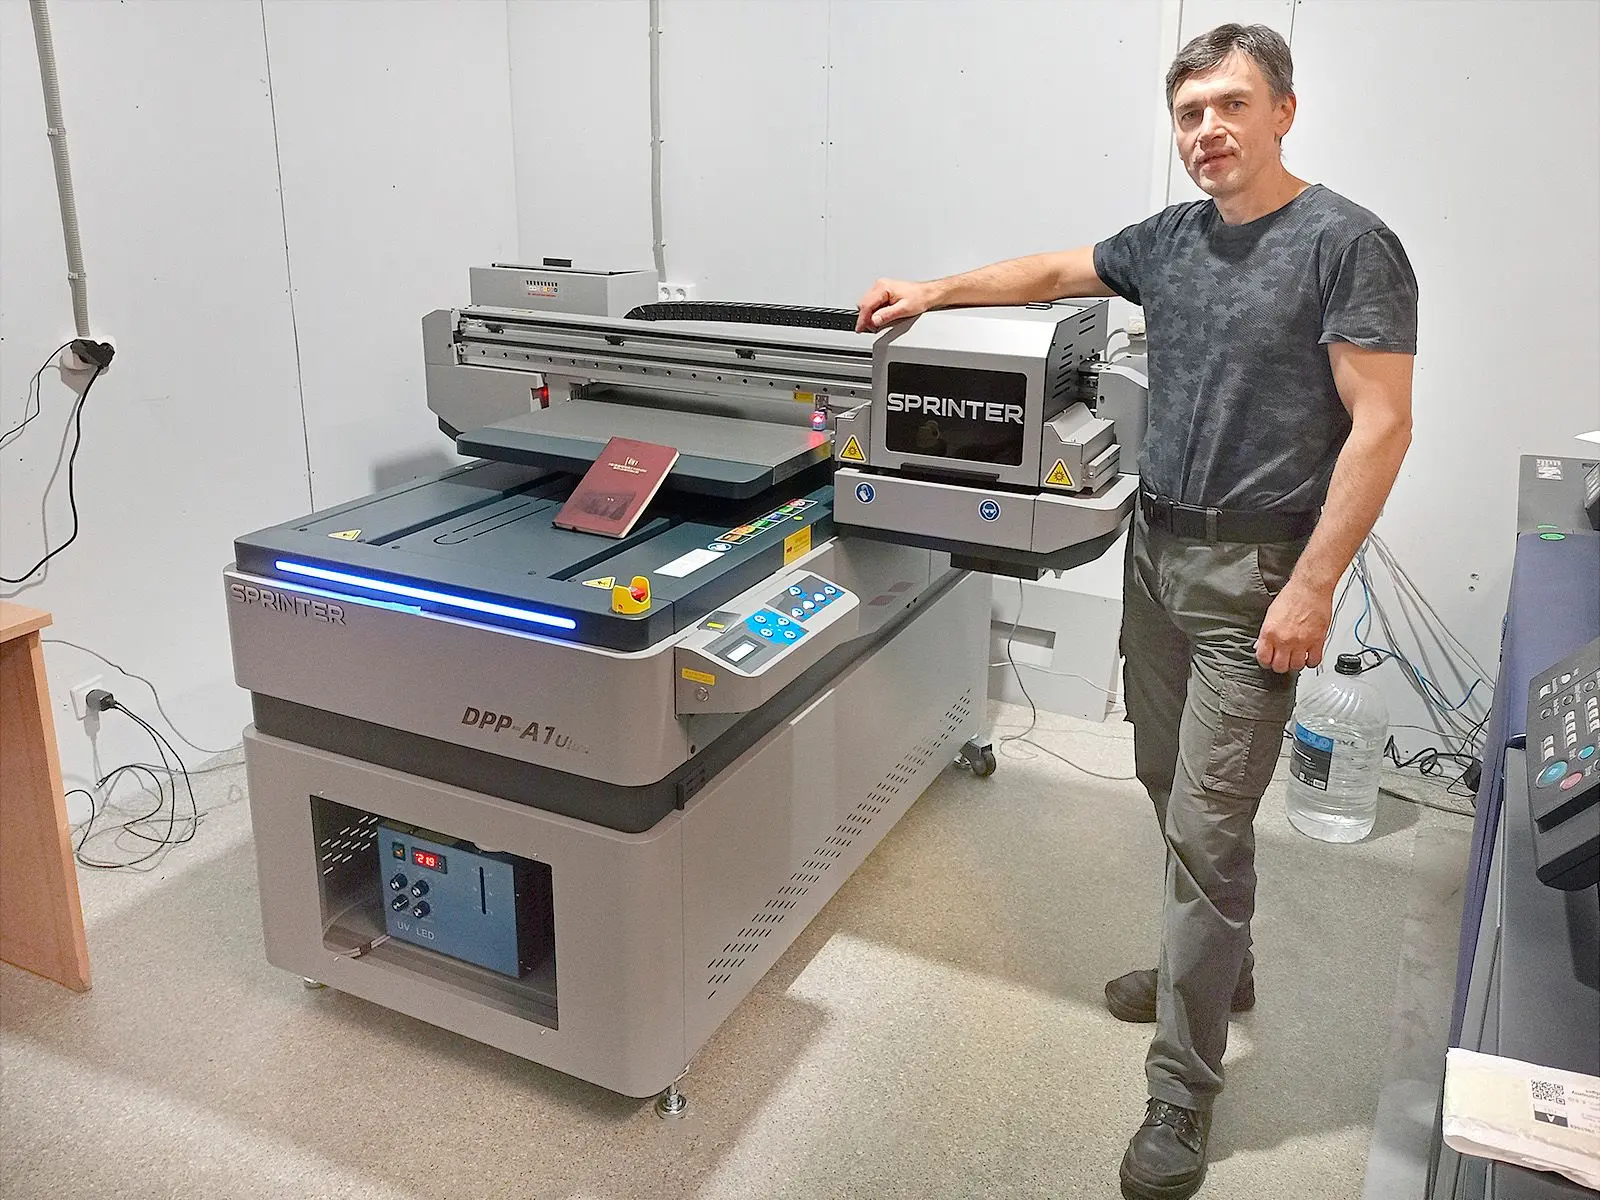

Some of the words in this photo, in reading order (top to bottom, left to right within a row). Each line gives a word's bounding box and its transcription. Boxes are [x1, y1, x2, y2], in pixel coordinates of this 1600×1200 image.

[887, 392, 1024, 425] SPRINTER
[230, 583, 347, 626] SPRINTER
[397, 921, 411, 932] UV
[416, 927, 435, 940] LED
